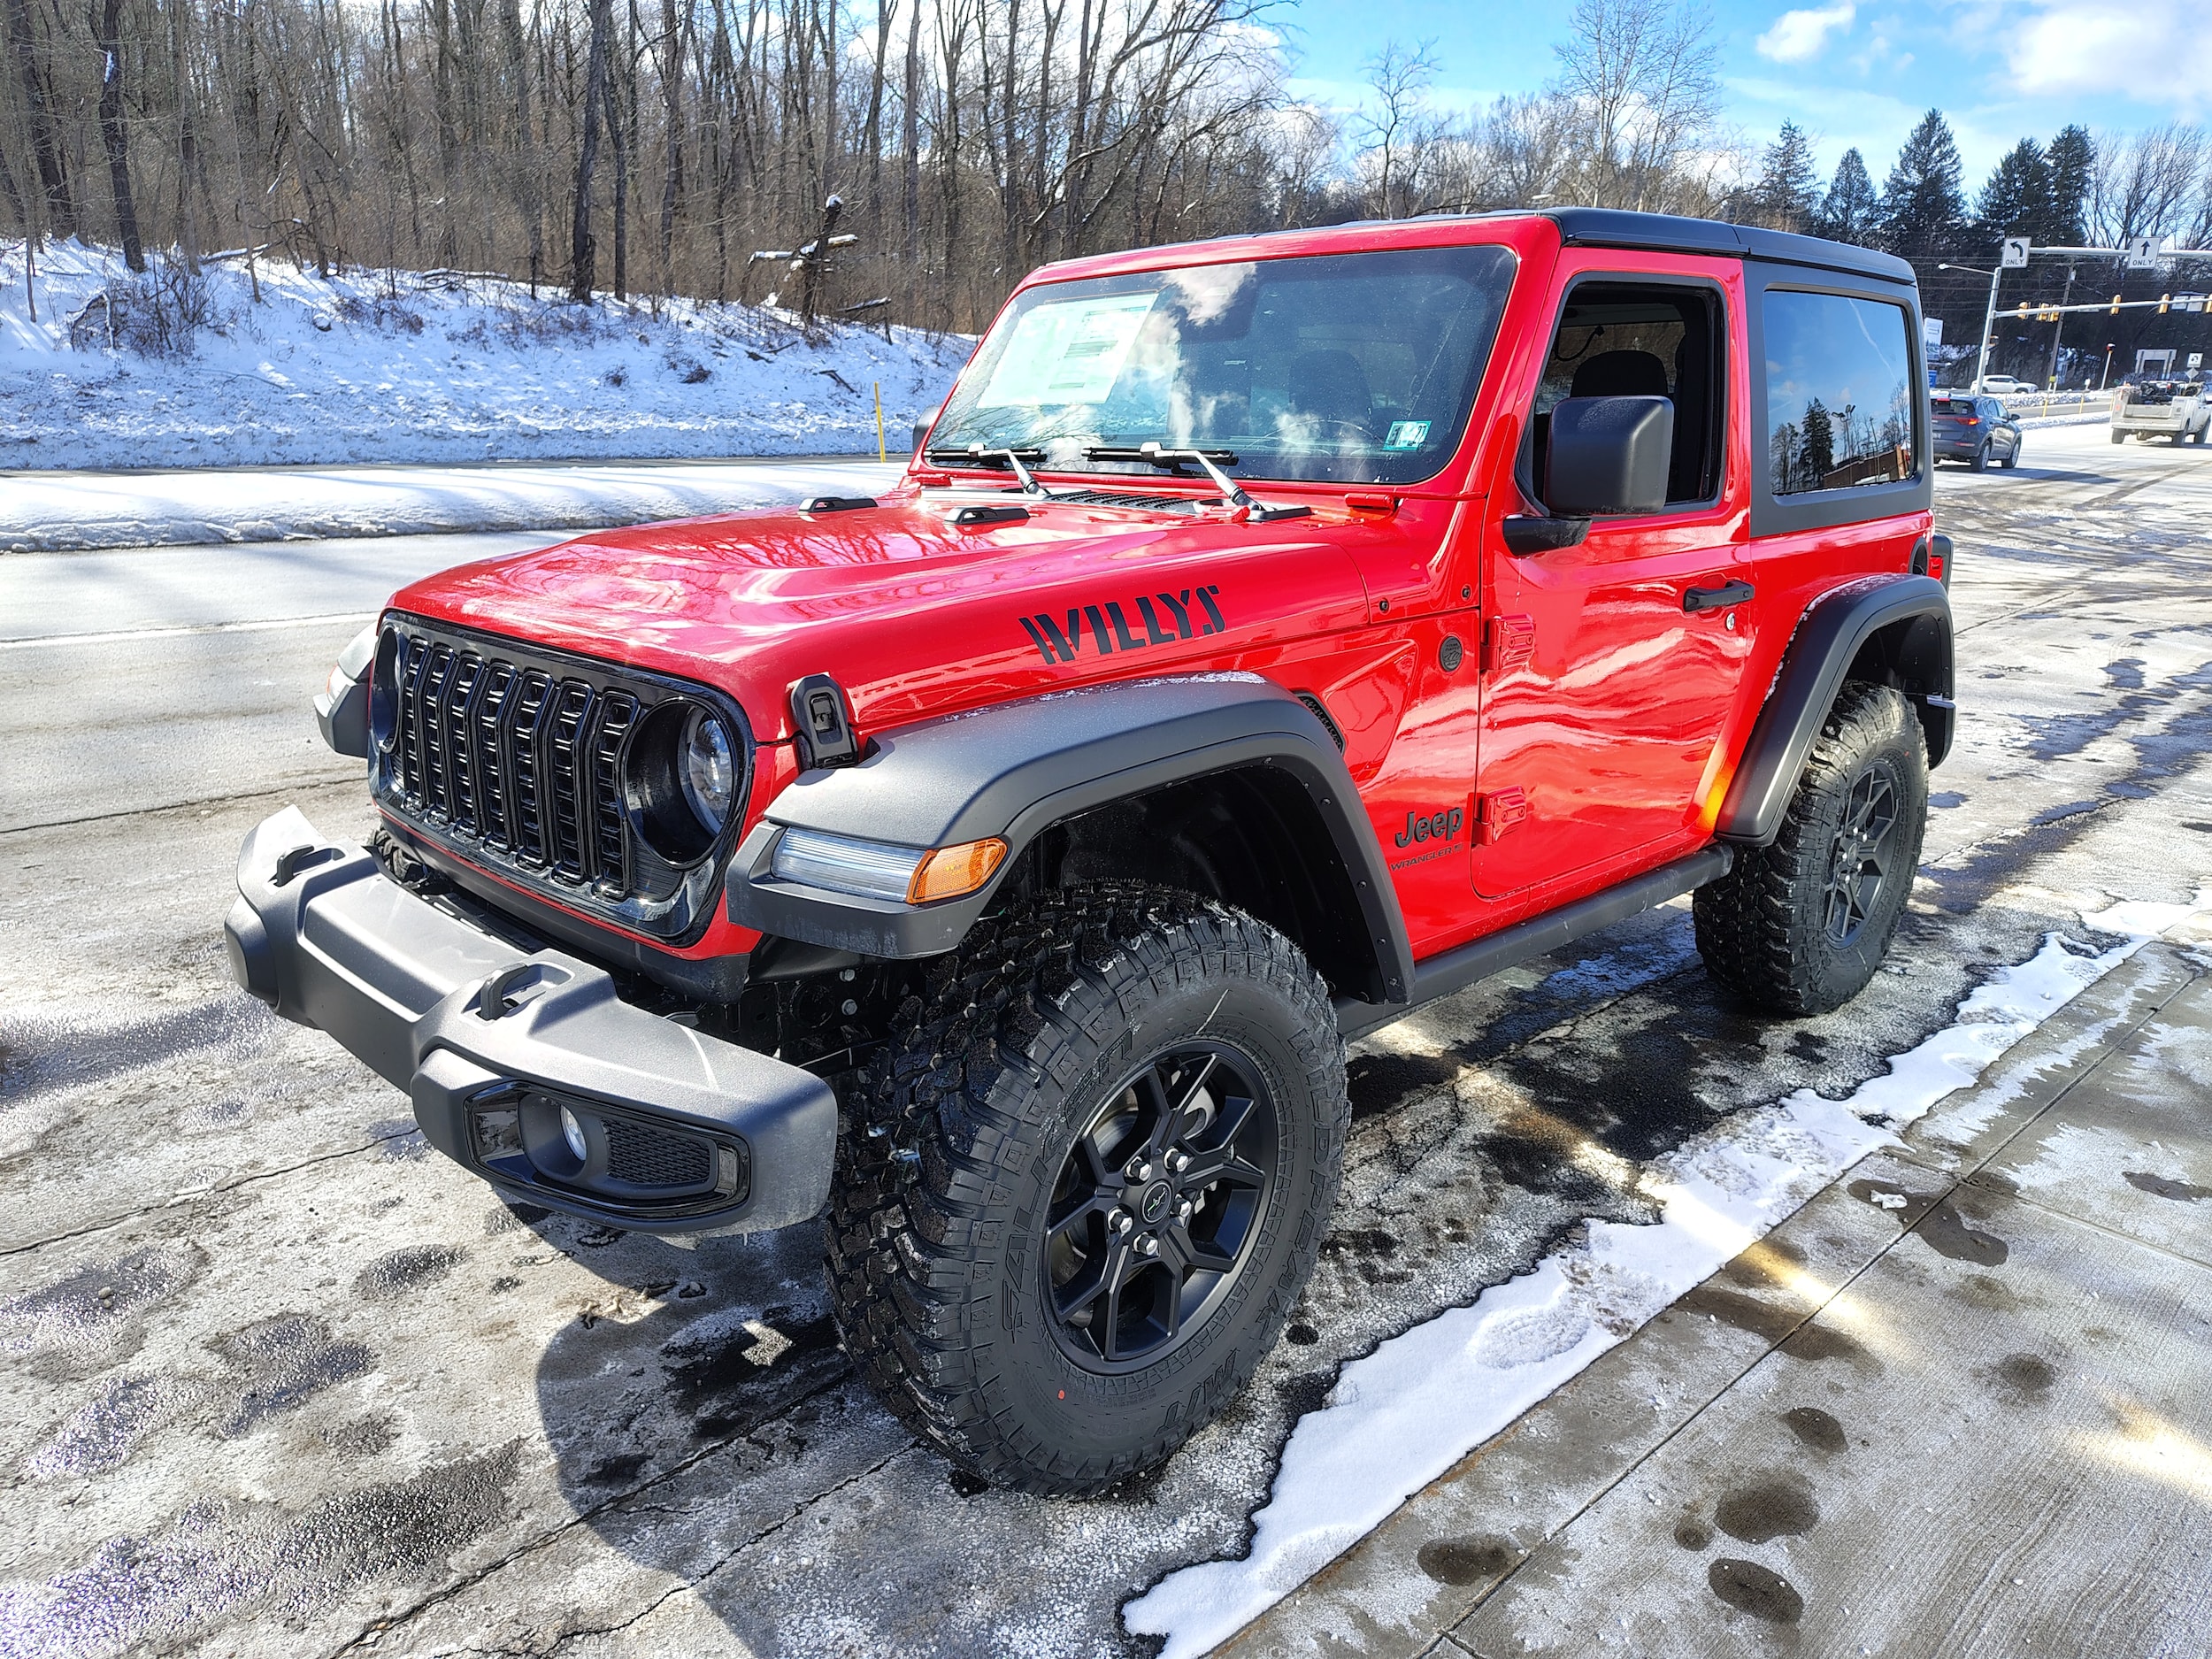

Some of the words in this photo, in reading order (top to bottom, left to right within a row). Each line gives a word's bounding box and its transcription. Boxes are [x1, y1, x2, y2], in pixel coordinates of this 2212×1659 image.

[1018, 585, 1225, 664] WILLYS
[1390, 847, 1453, 872] WRANGLER
[1394, 807, 1463, 848] Jeep
[1002, 1028, 1134, 1344] FALKEN
[1254, 1027, 1333, 1342] WILDPEAK
